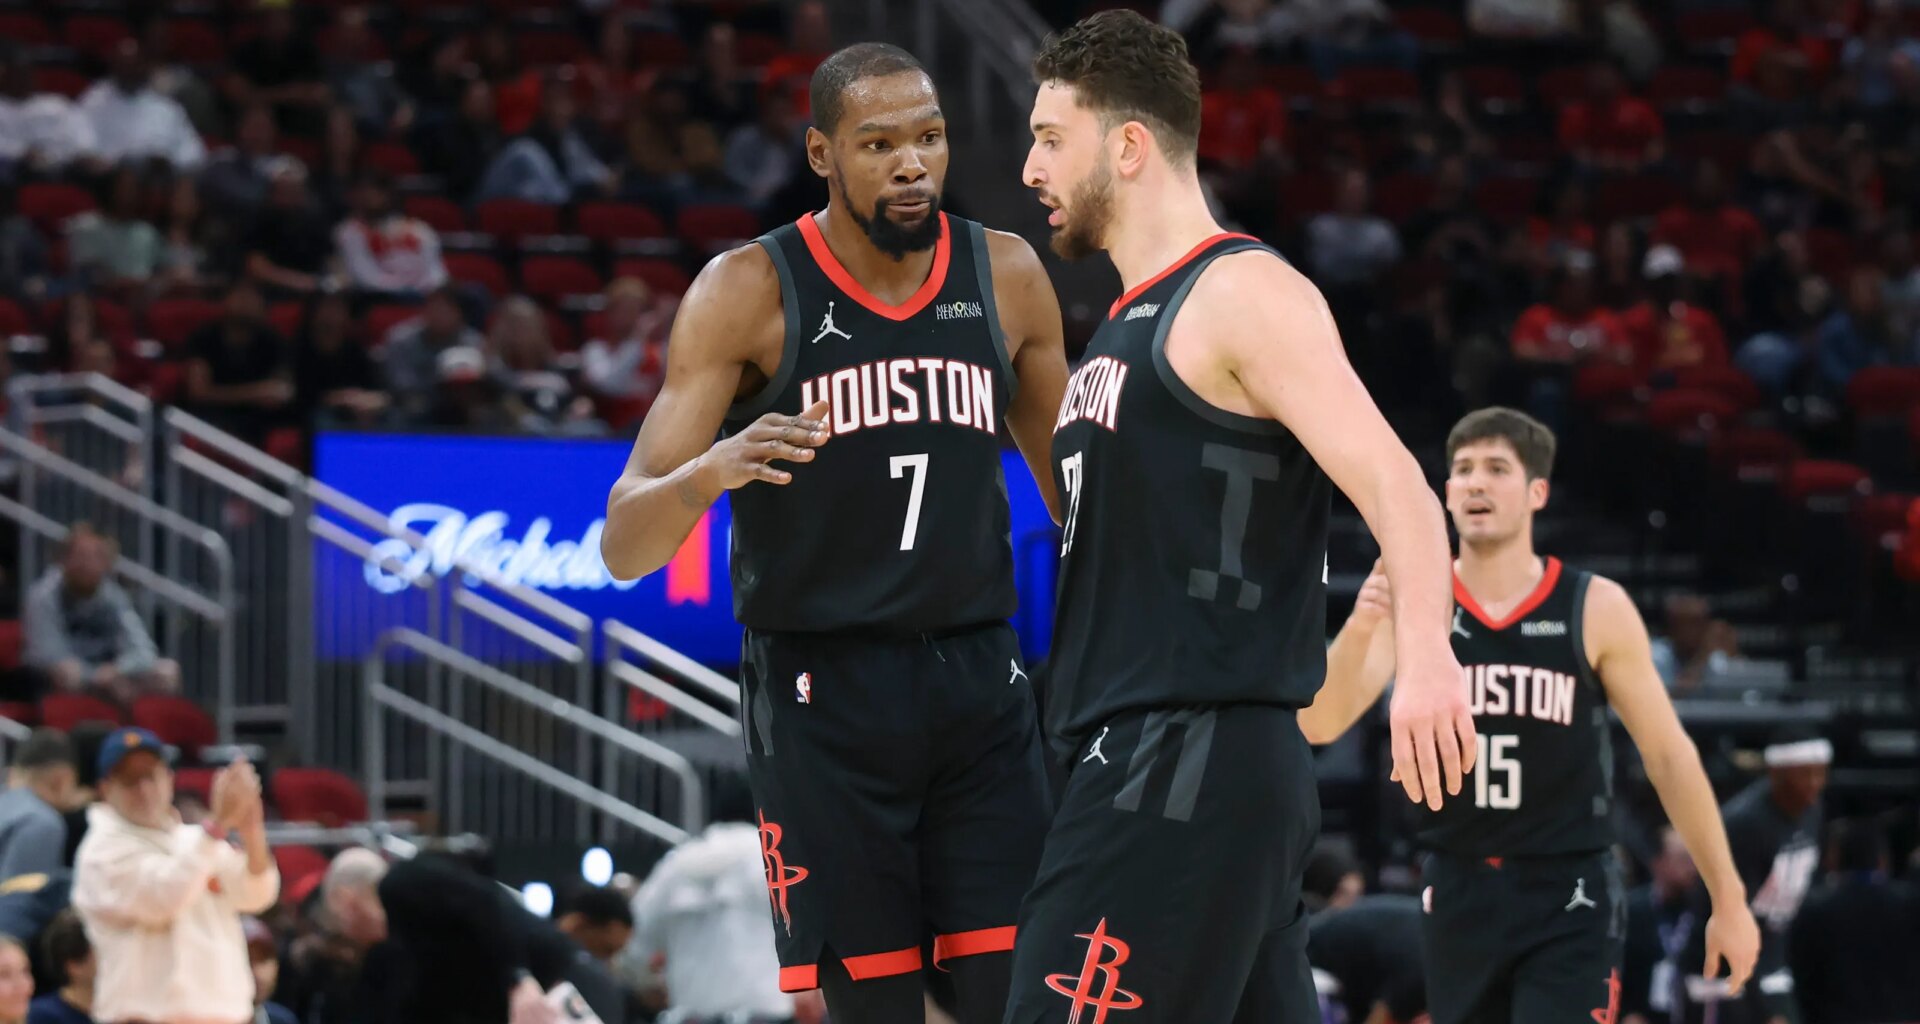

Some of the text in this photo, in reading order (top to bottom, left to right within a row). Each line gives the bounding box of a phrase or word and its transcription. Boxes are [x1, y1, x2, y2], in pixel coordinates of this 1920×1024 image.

[936, 301, 981, 313] MEMORIAL
[936, 308, 983, 320] HERMANN
[889, 453, 929, 551] 7
[1463, 663, 1577, 727] USTON
